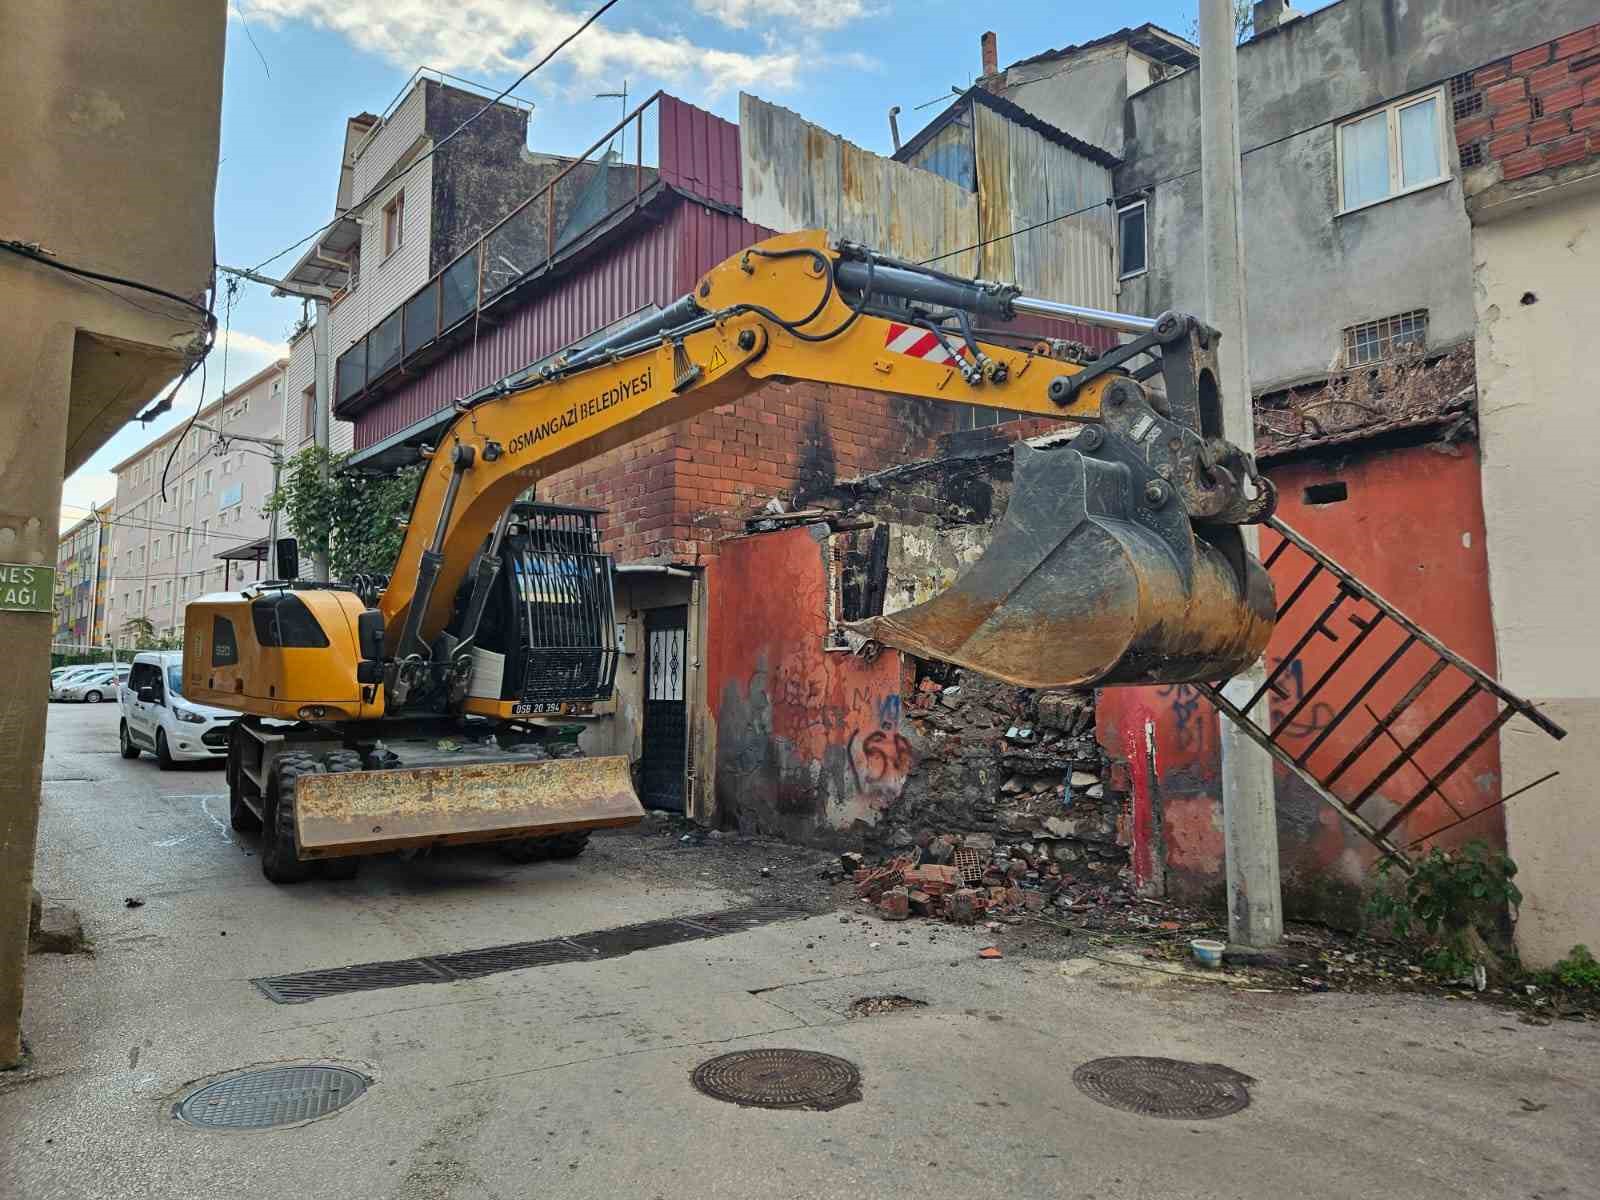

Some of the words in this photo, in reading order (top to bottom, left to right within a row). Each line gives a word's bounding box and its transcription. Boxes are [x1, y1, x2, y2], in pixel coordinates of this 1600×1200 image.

[508, 402, 578, 455] OSMANGAZİ
[580, 366, 652, 422] BELEDİYESİ
[533, 703, 544, 713] 20
